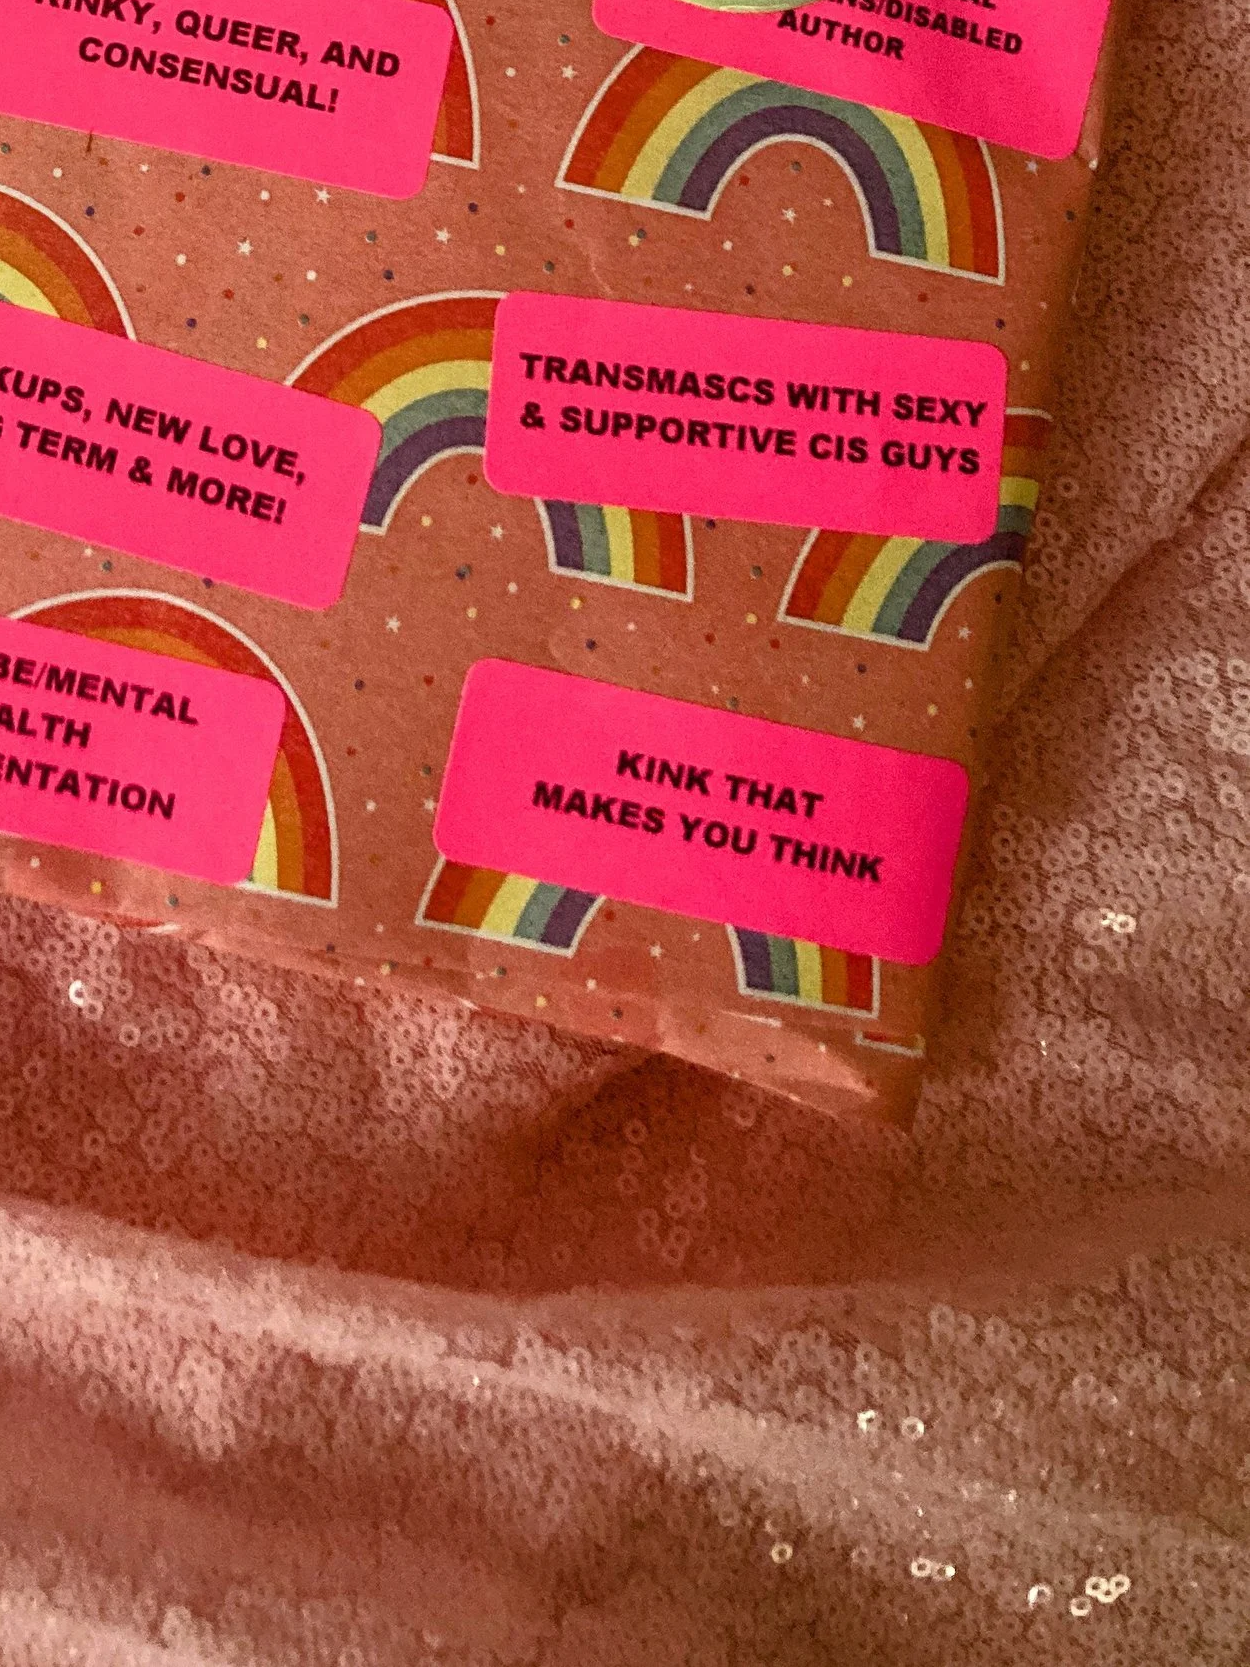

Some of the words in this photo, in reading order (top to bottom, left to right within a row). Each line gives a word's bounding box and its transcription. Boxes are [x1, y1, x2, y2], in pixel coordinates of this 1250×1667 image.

[175, 9, 308, 64] QUEER,
[320, 40, 400, 77] AND
[777, 10, 905, 61] AUTHOR
[78, 36, 339, 113] CONSENSUAL!
[520, 352, 775, 406] TRANSMASCS
[786, 382, 881, 417] WITH
[892, 393, 987, 428] SEXY
[17, 421, 118, 474] TERM
[127, 456, 153, 486] &
[166, 467, 286, 525] MORE!
[105, 398, 191, 444] NEW
[199, 426, 305, 485] LOVE,
[519, 401, 545, 429] &
[560, 406, 796, 457] SUPPORTIVE
[808, 433, 869, 464] CIS
[880, 440, 980, 475] GUYS
[616, 750, 711, 796] KINK
[725, 774, 824, 819] THAT
[532, 781, 665, 835] MAKES
[680, 814, 757, 856] YOU
[770, 834, 883, 883] THINK
